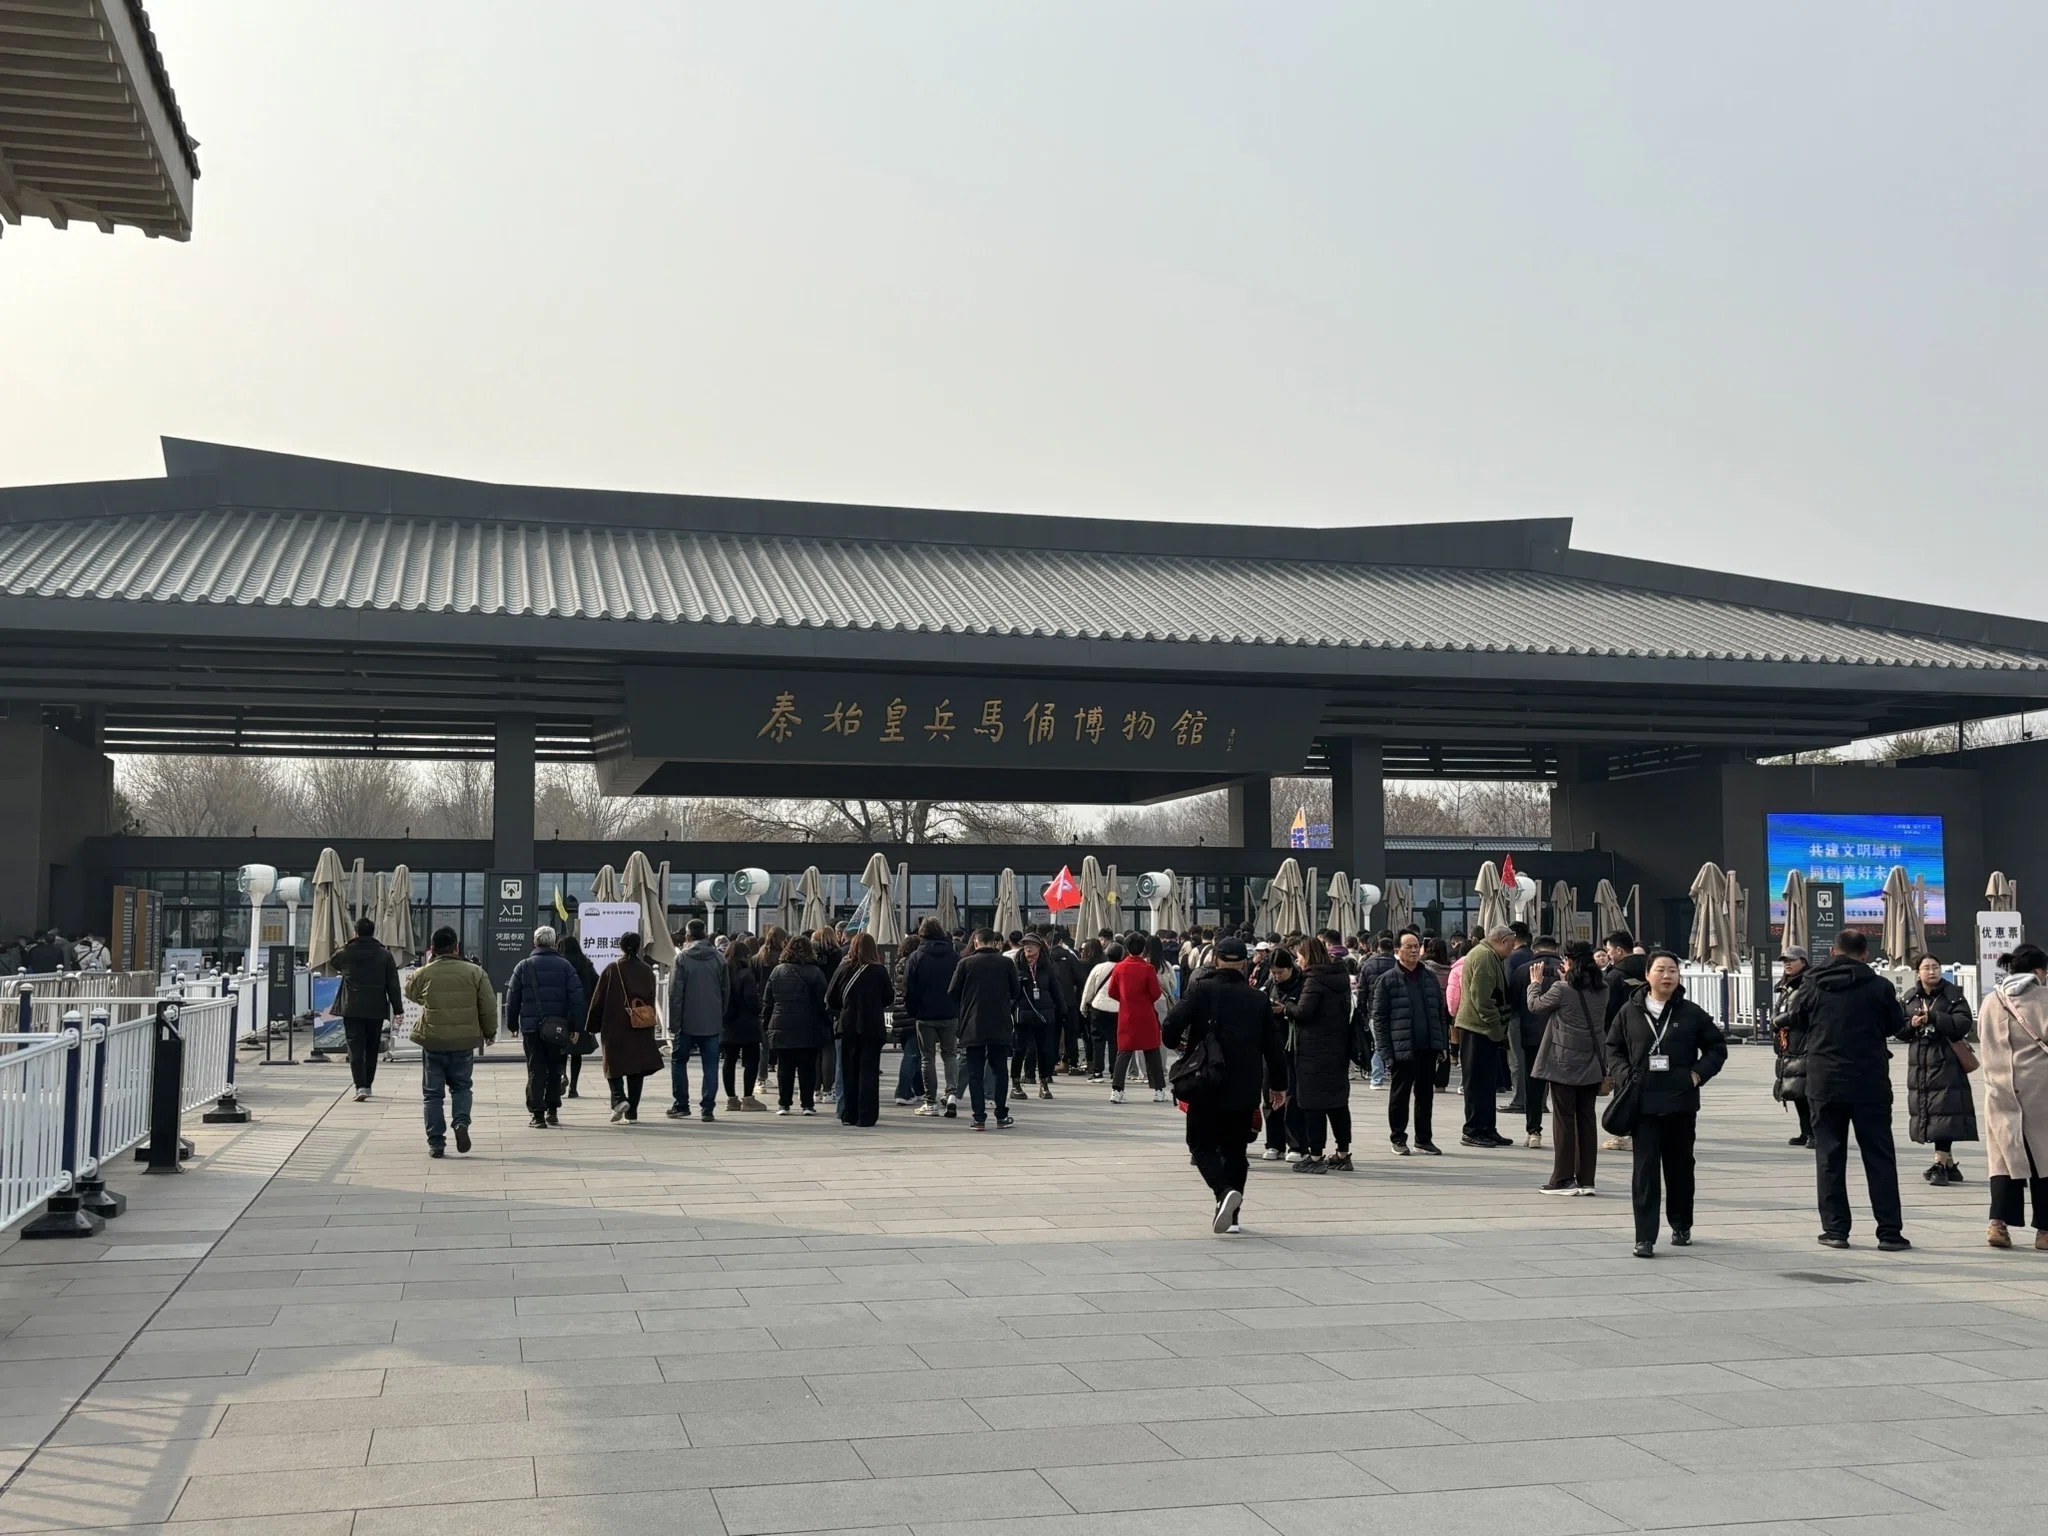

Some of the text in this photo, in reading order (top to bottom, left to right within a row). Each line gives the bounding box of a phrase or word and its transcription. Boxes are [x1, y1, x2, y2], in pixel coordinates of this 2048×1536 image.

[1809, 843, 1902, 858] 共建文明城市
[1810, 865, 1892, 880] 同创美好未
[499, 904, 523, 916] 入口
[1817, 912, 1834, 921] 入口
[496, 933, 525, 941] 凭票参观
[1982, 926, 2018, 939] 优惠票
[583, 936, 621, 949] 护照通
